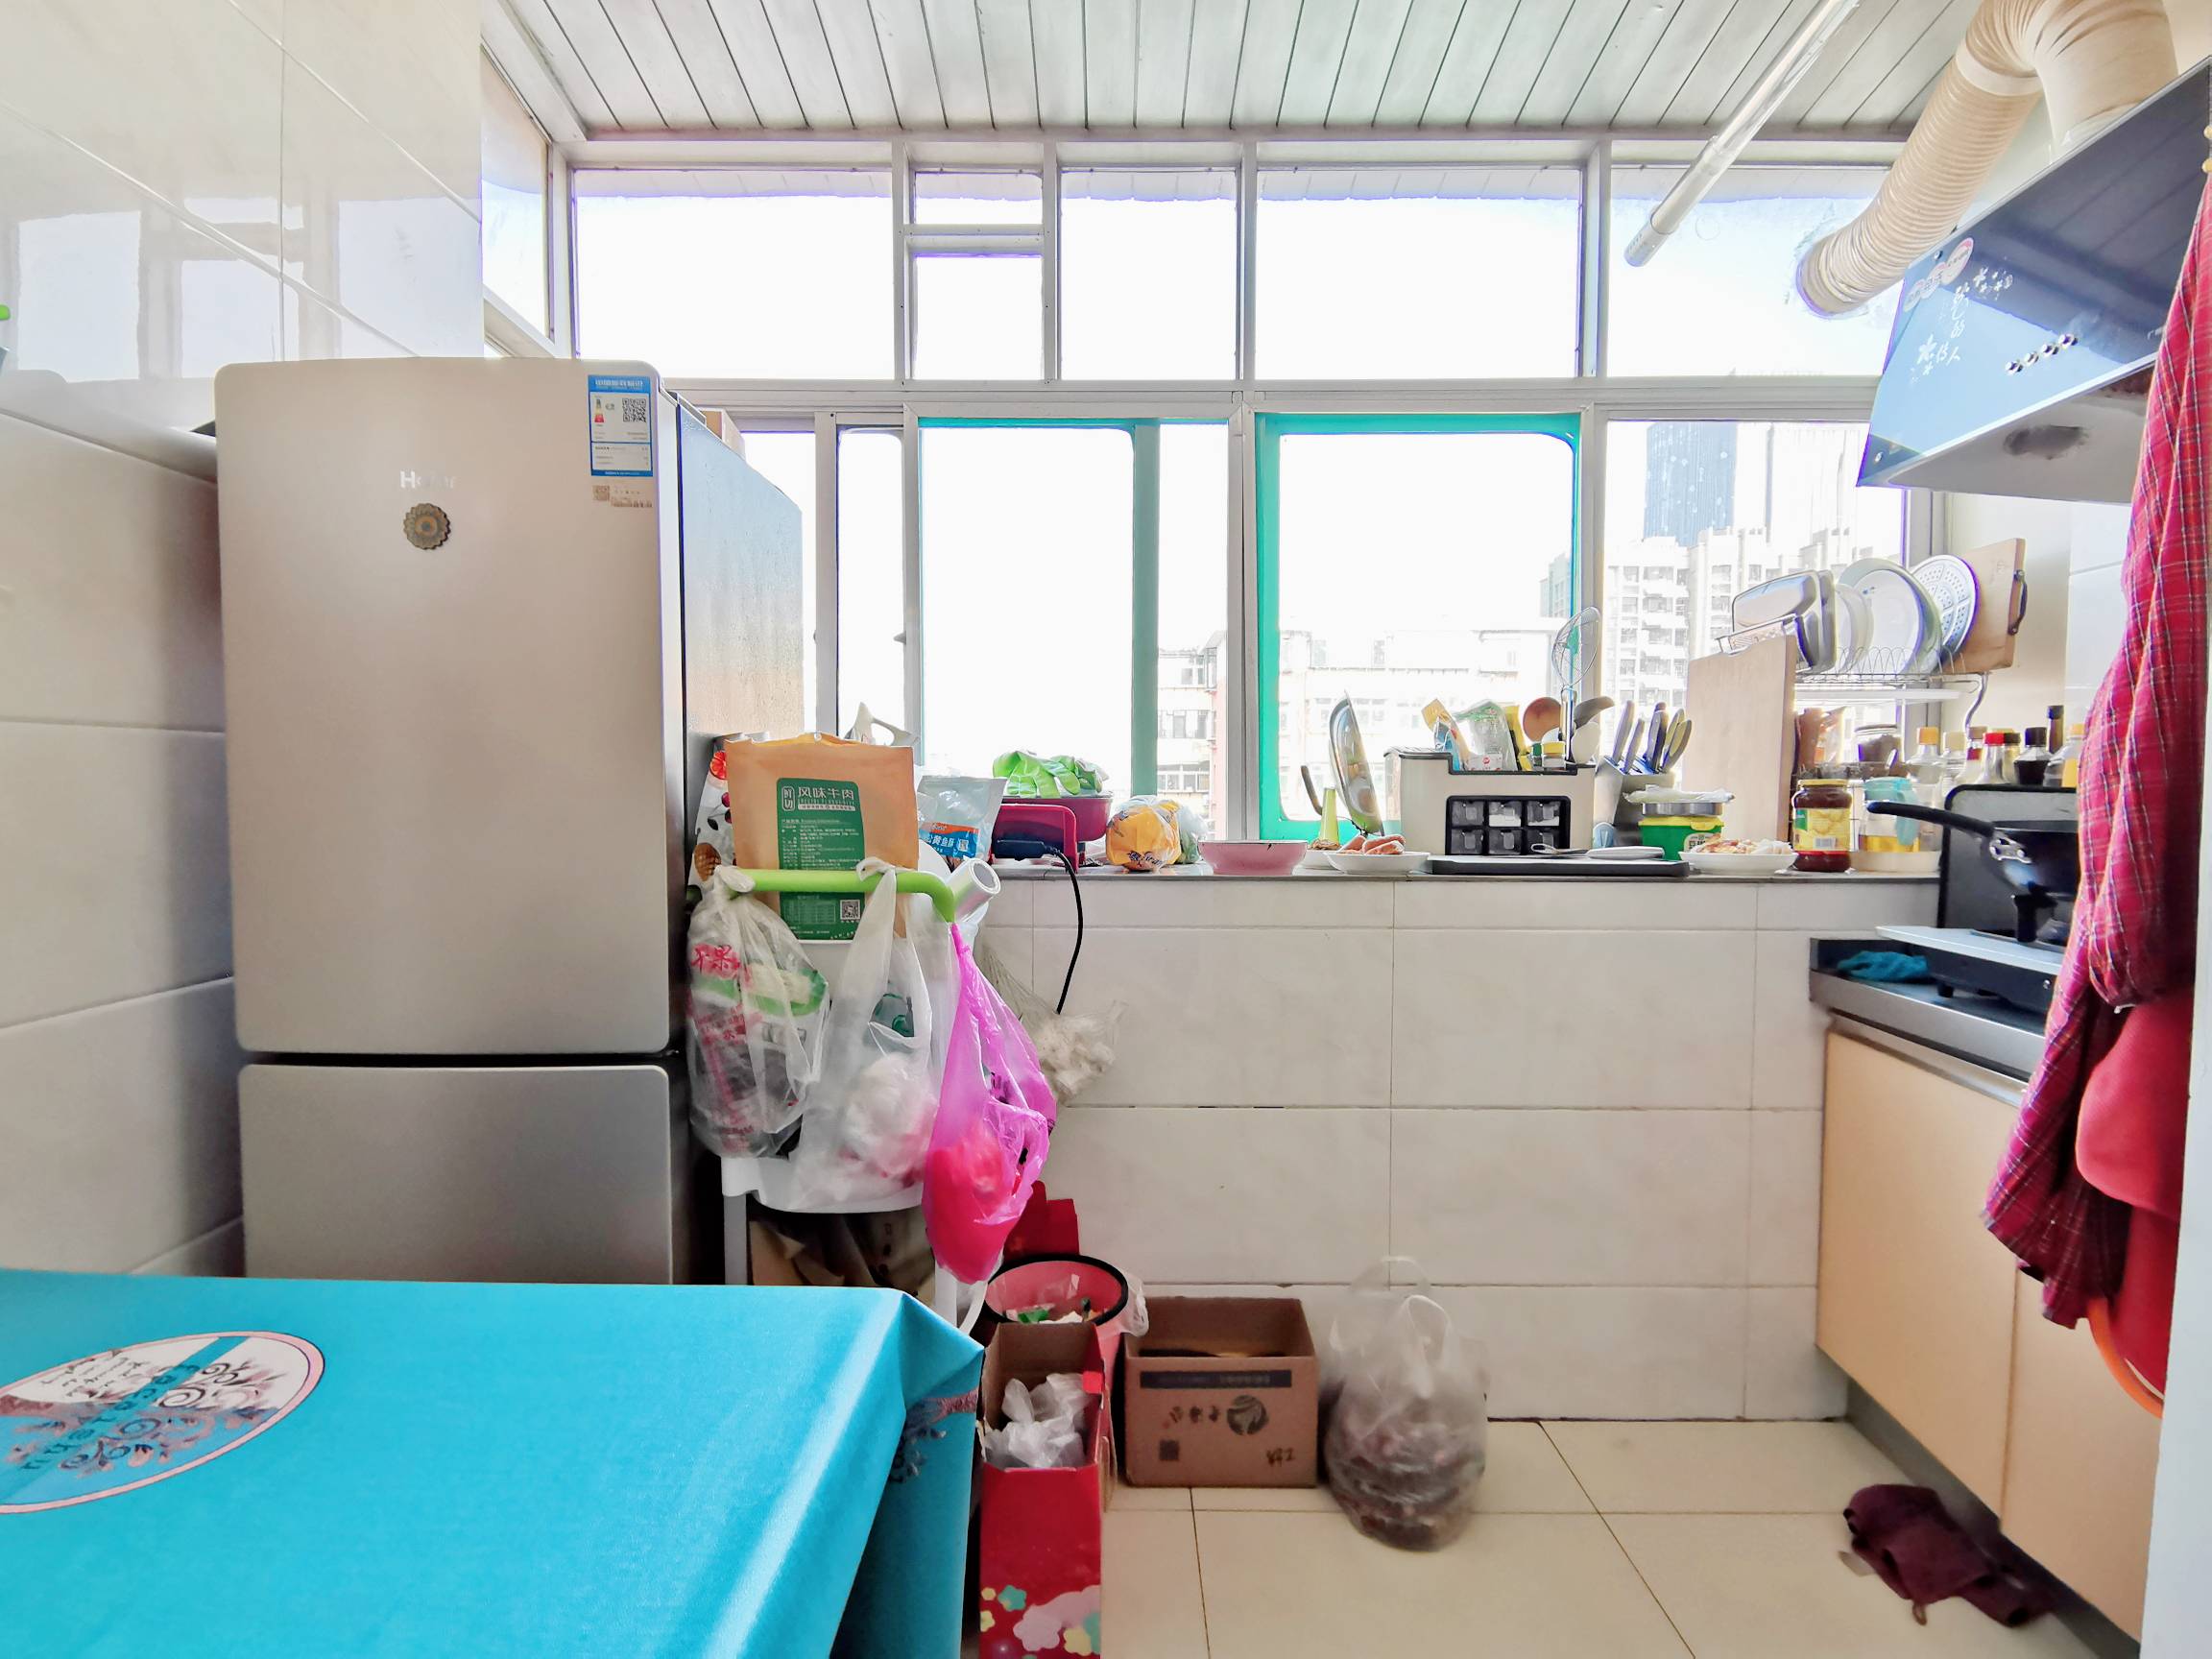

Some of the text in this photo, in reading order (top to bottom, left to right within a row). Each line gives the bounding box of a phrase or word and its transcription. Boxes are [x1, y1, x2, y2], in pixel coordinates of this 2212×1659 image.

[399, 470, 456, 489] Har
[797, 786, 854, 801] 风味牛肉
